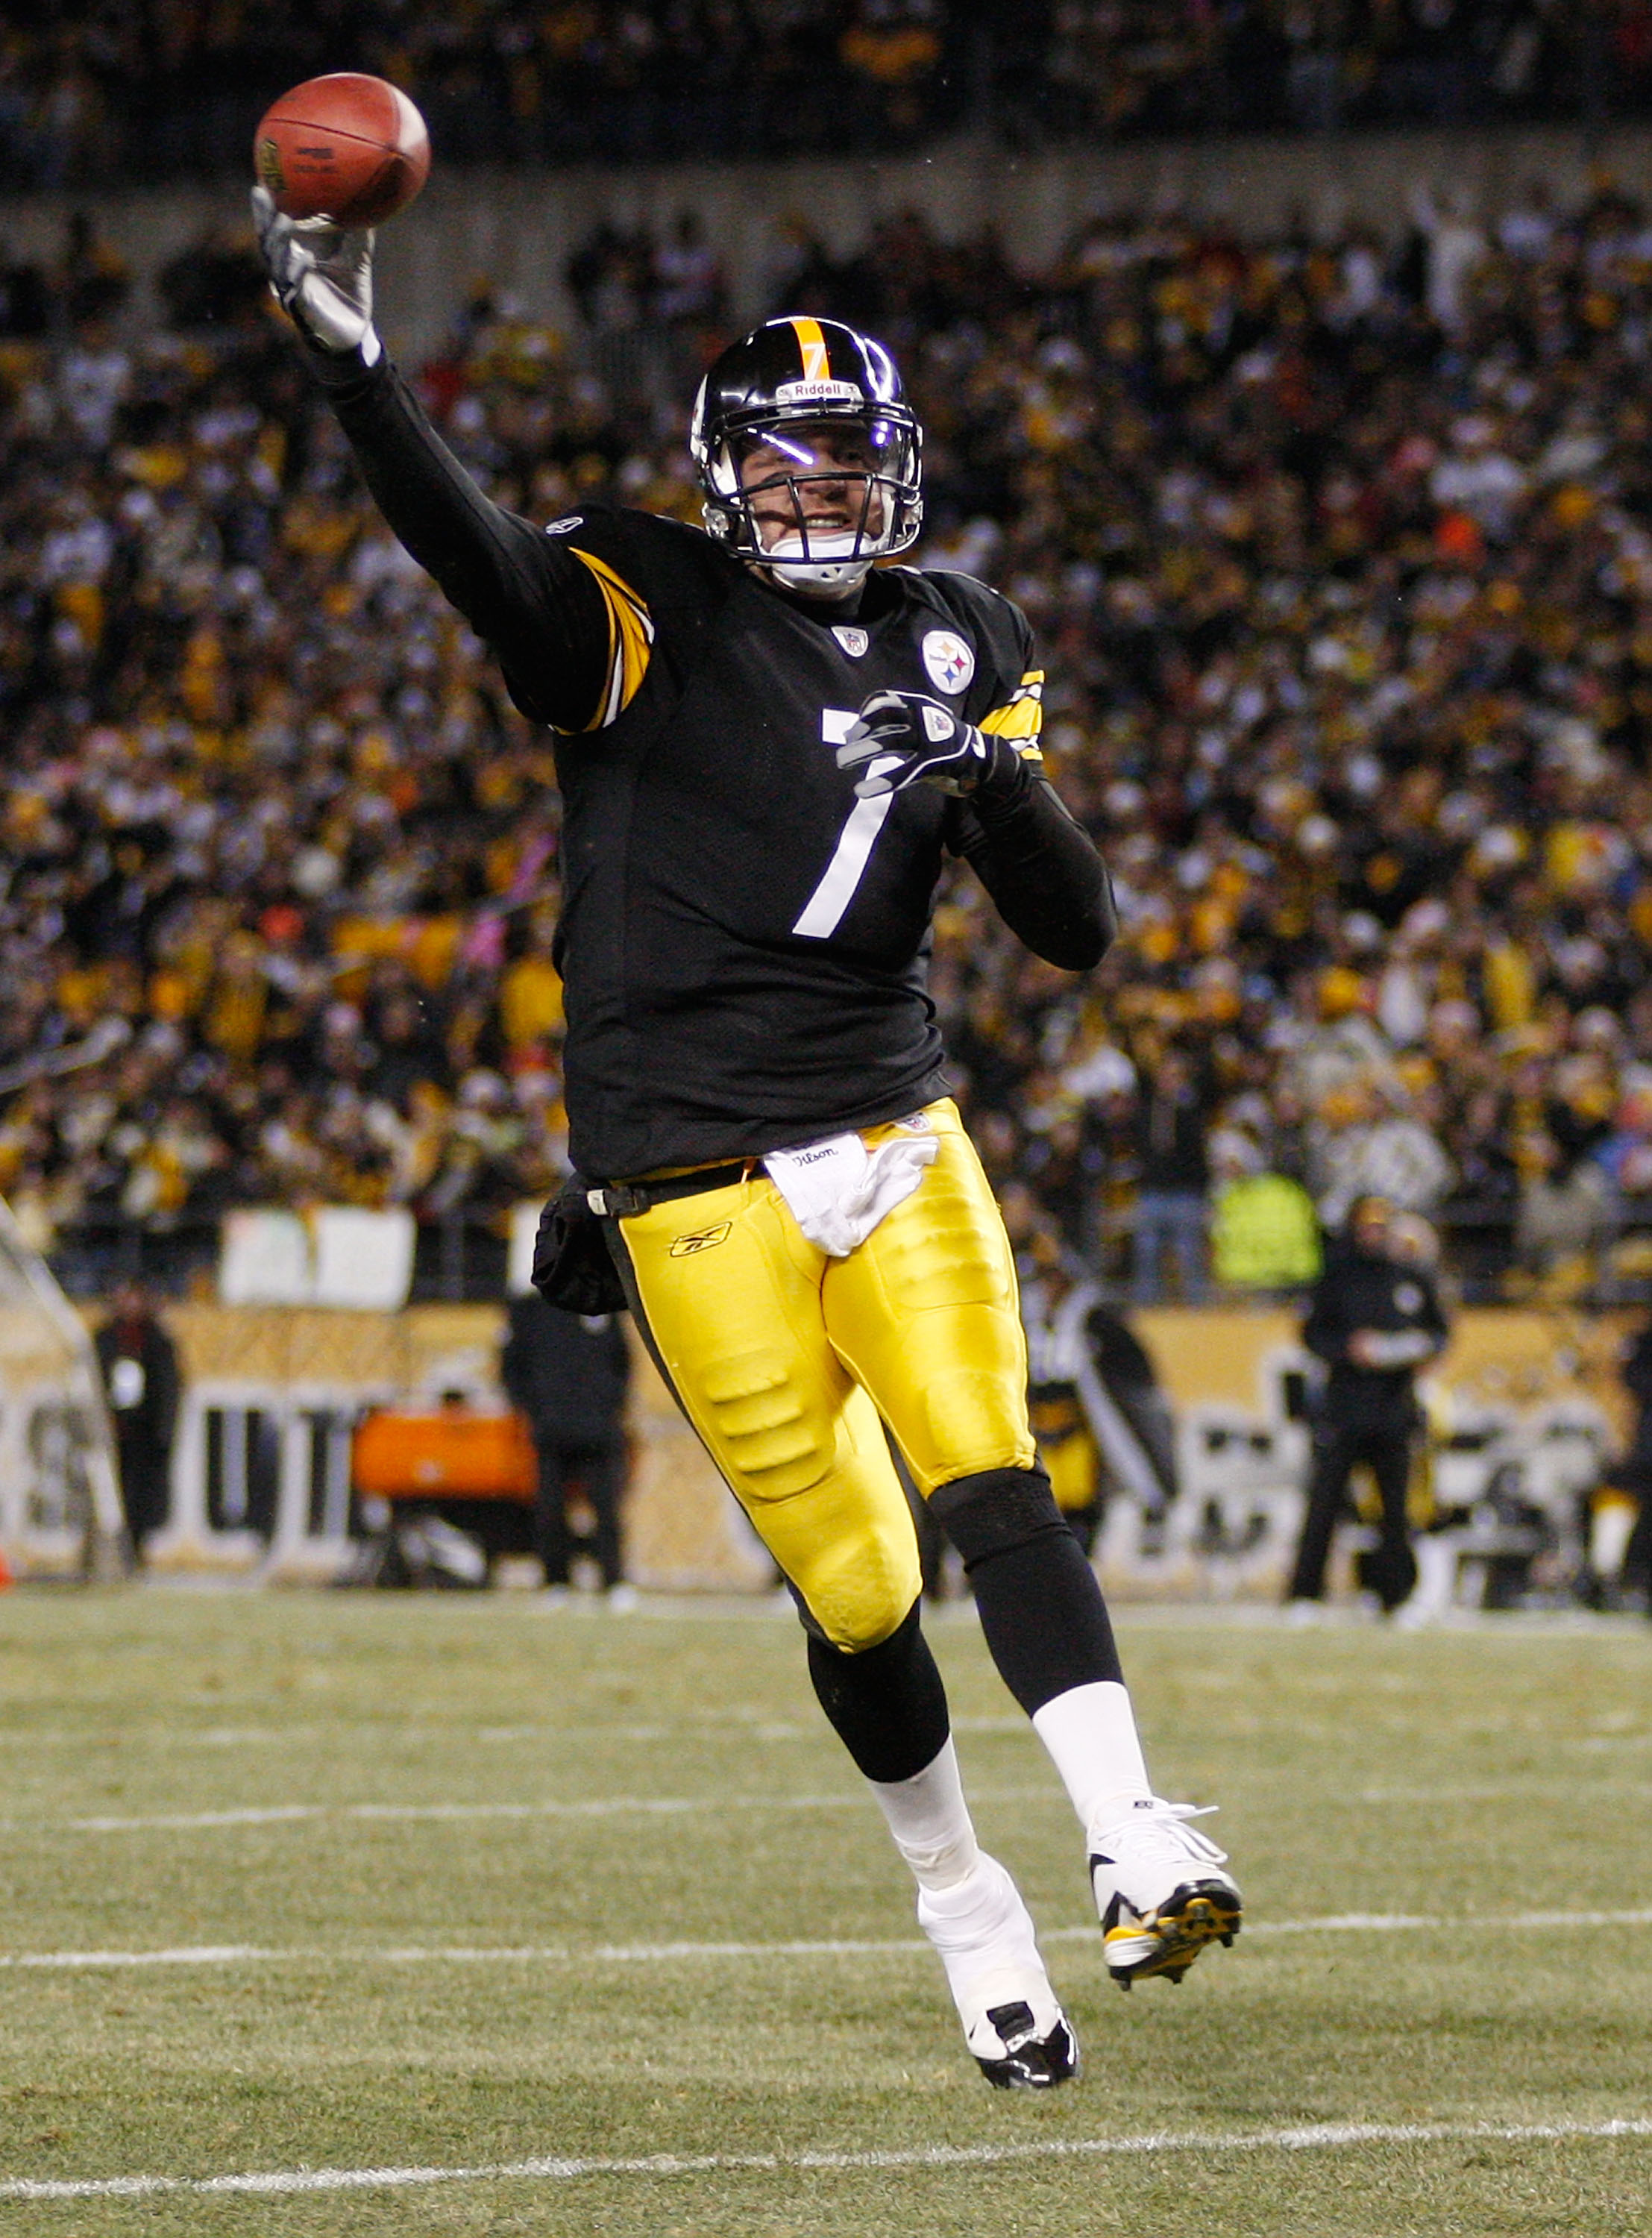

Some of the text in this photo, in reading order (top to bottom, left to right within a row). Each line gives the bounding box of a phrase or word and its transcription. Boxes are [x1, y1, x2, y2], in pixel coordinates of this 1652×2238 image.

[803, 343, 826, 380] 7
[795, 383, 841, 395] Riddell
[792, 707, 905, 939] 7
